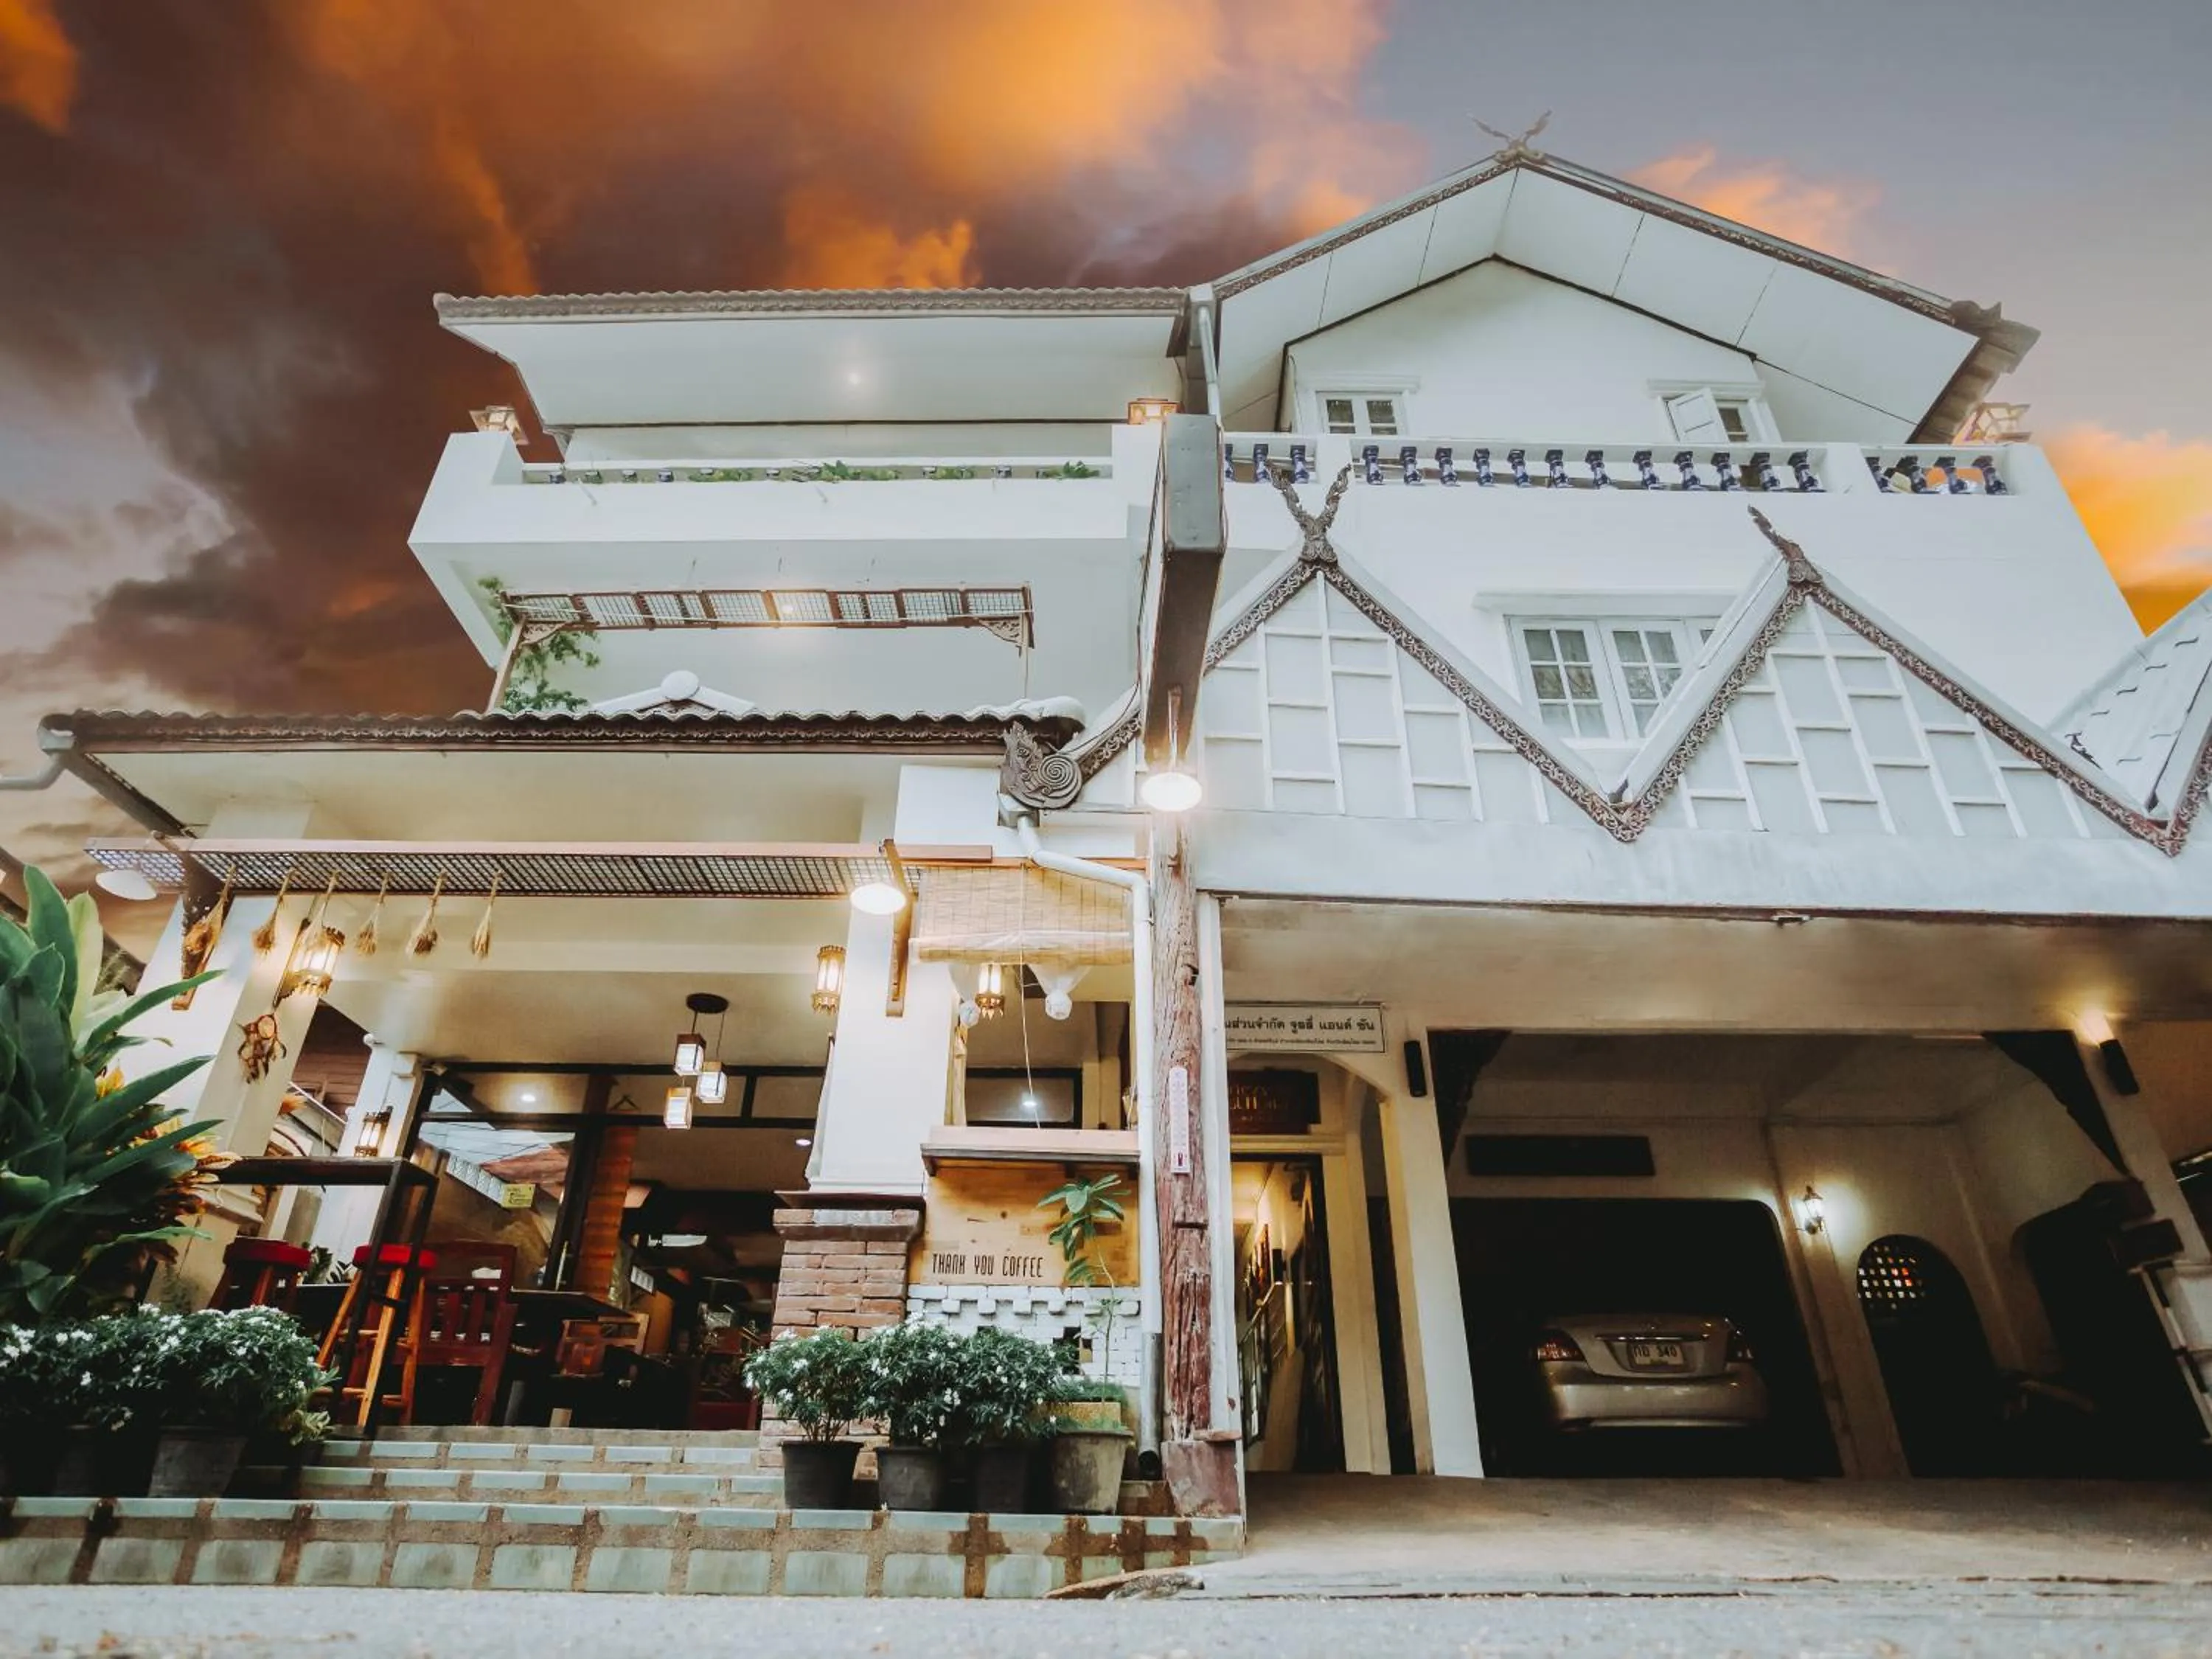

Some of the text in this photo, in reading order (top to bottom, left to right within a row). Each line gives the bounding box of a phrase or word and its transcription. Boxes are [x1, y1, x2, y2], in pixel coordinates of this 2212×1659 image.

[932, 1253, 1043, 1278] THANK YOU COFFEE
